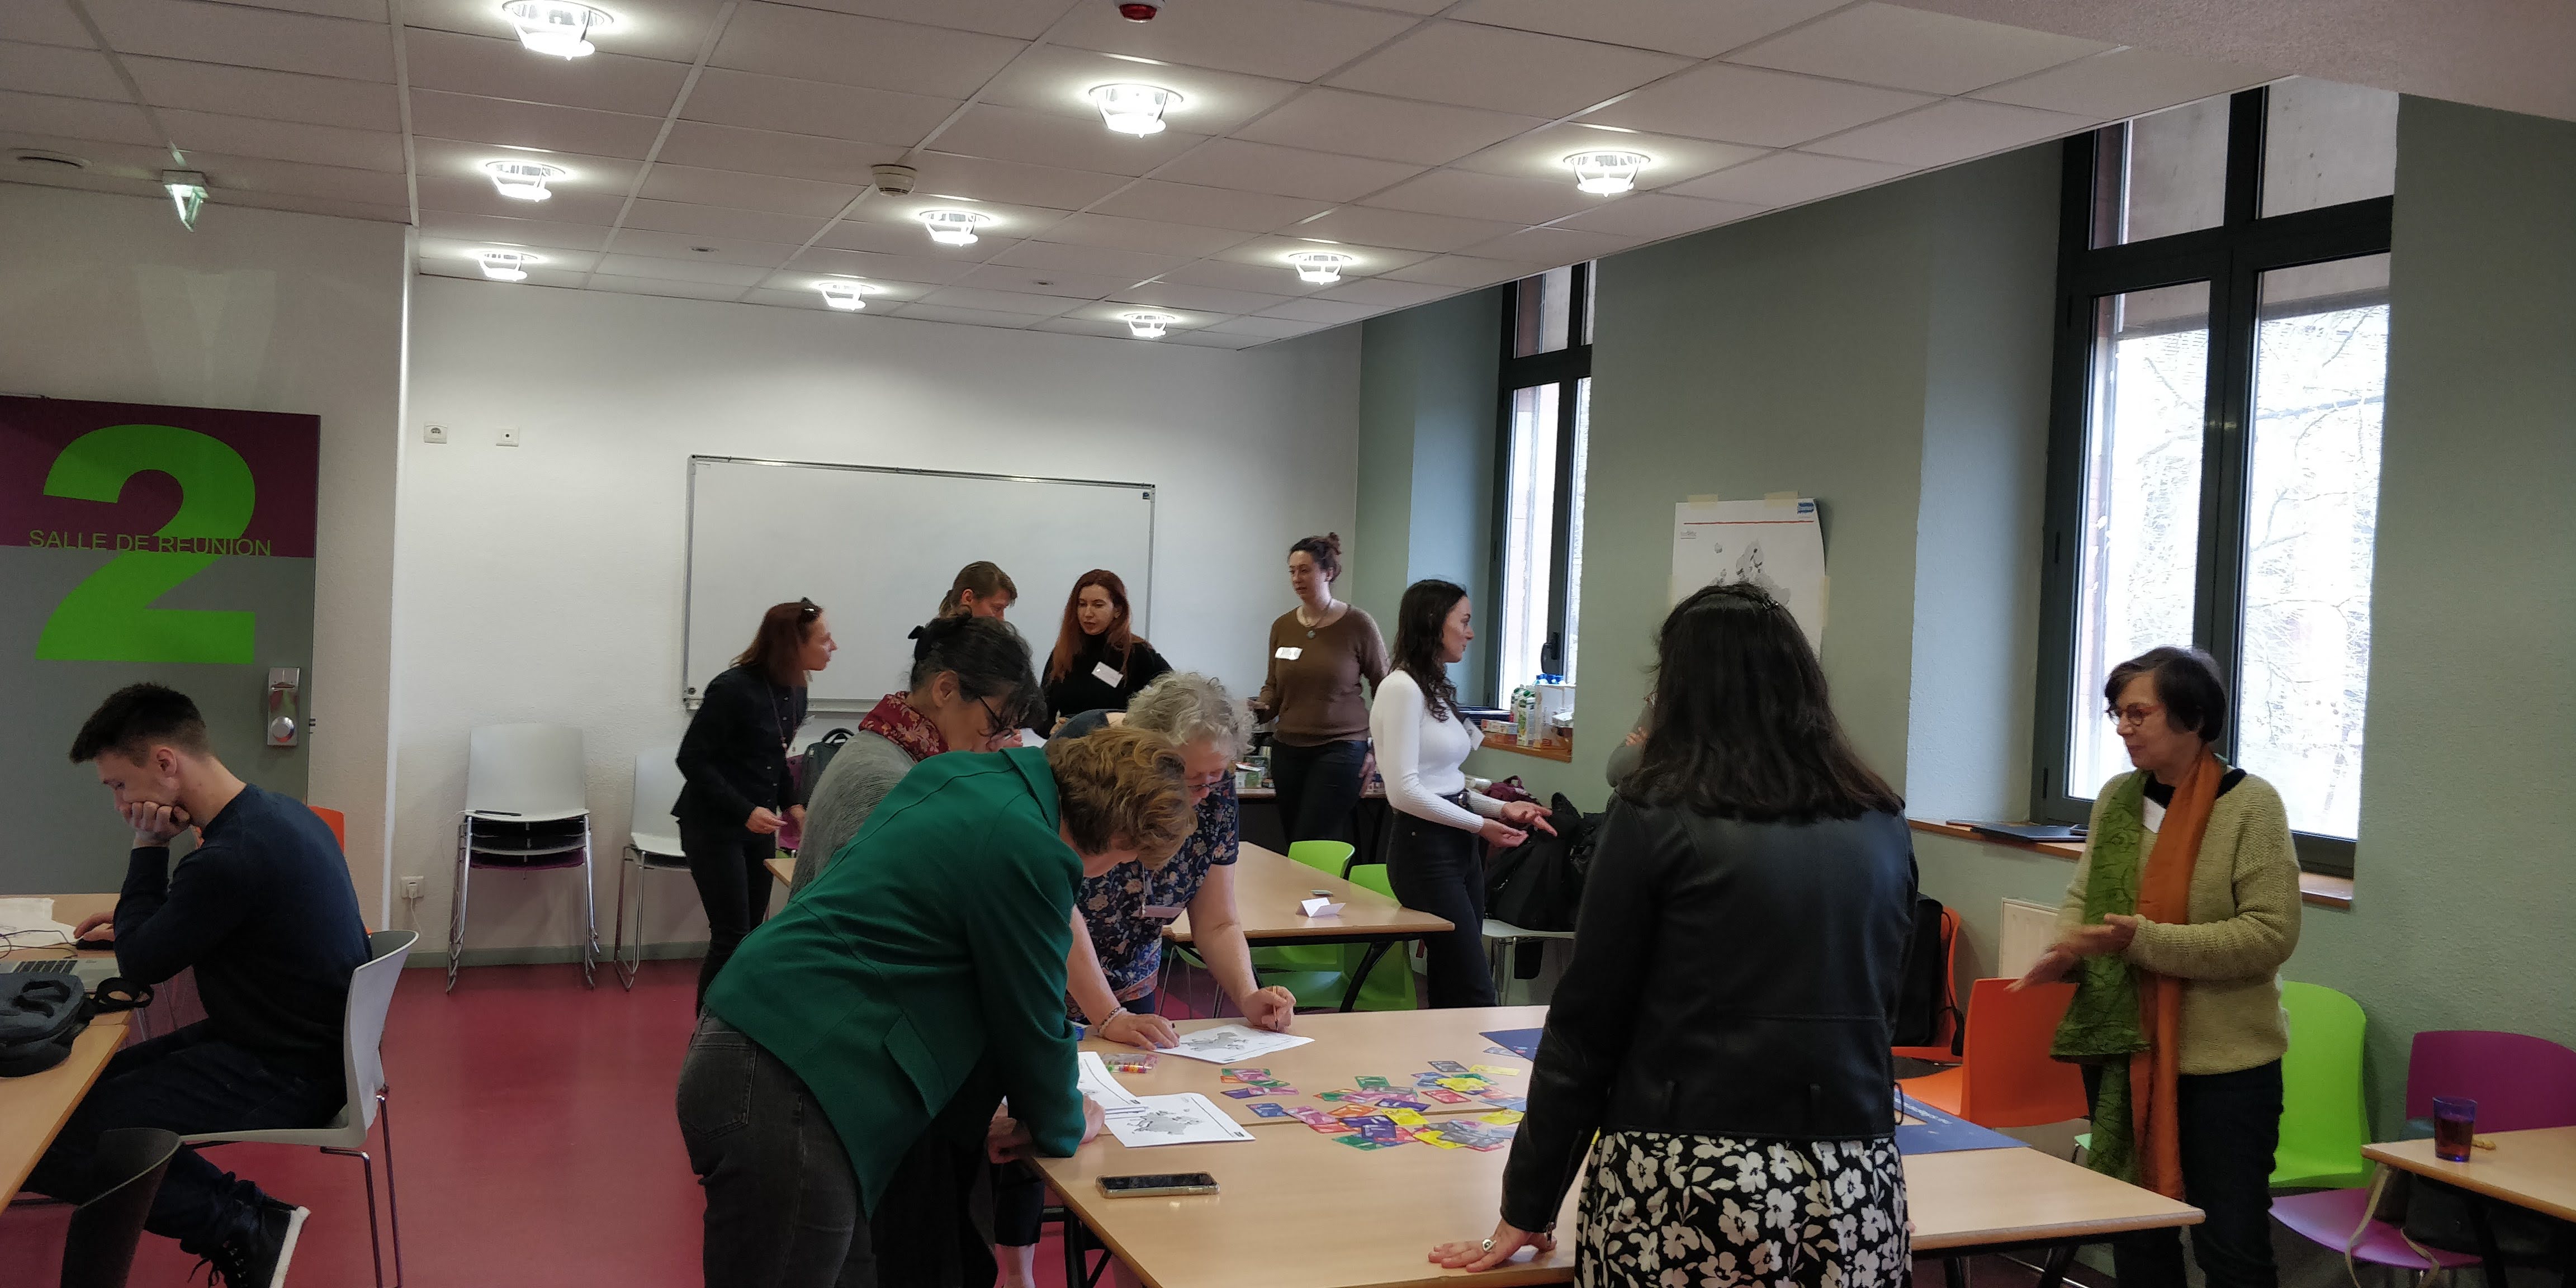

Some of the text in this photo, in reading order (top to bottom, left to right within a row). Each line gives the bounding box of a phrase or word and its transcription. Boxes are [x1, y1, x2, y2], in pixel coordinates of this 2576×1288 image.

[29, 529, 271, 556] SALLE DE REUNION
[35, 424, 255, 664] 2
